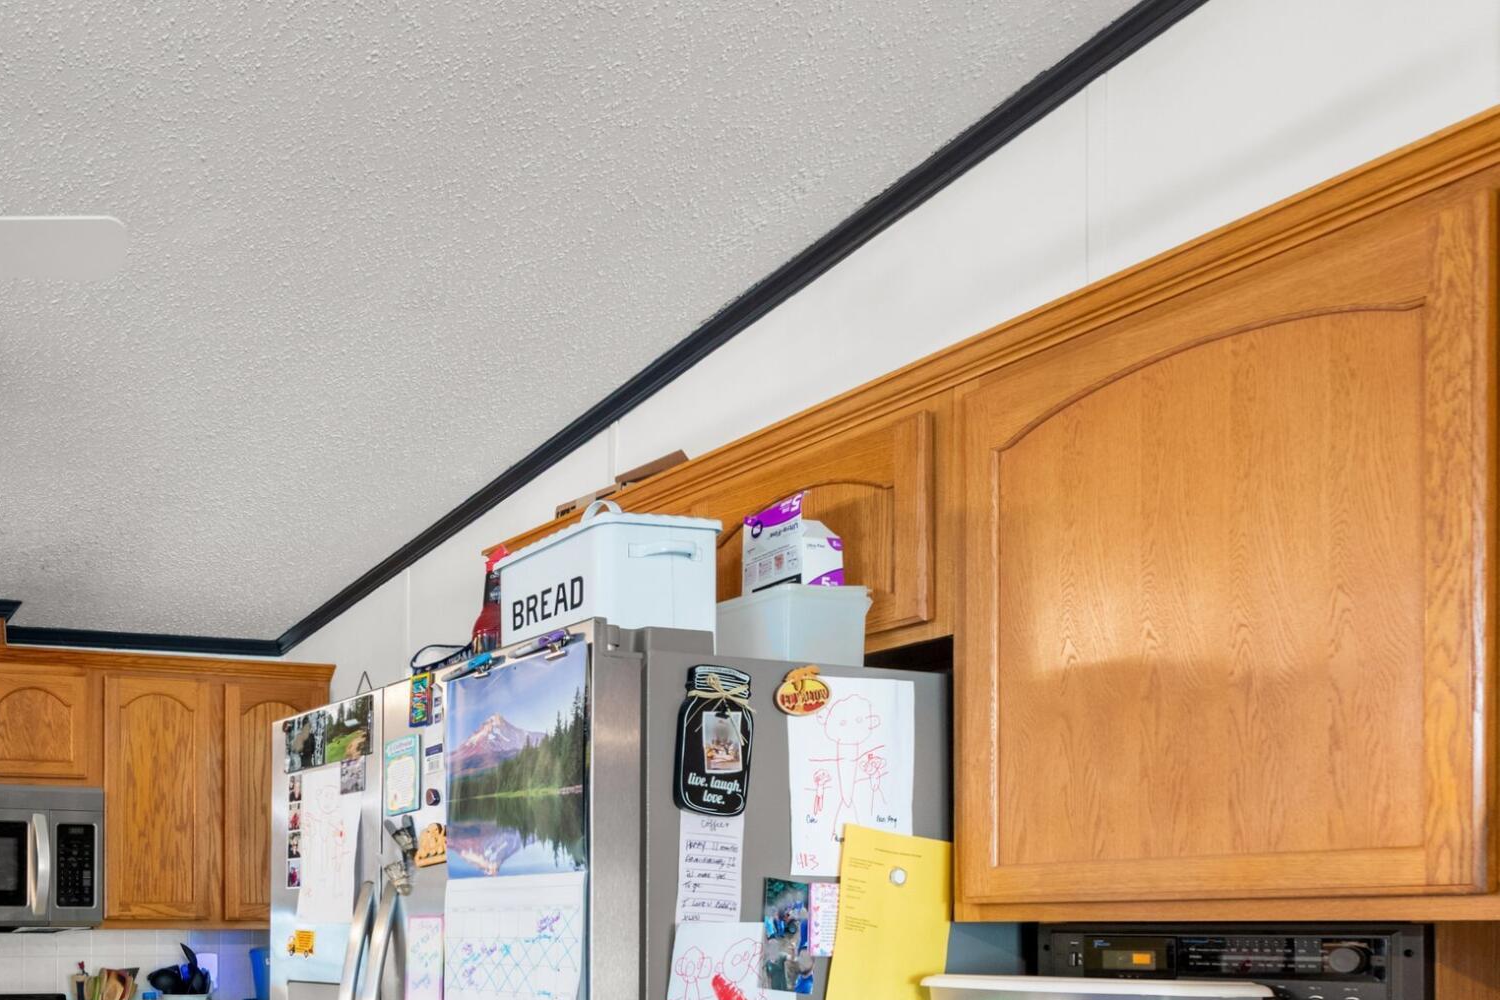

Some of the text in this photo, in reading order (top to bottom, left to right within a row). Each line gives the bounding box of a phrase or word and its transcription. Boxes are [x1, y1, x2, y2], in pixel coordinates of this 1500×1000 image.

[512, 575, 584, 632] BREAD
[687, 772, 742, 794] live. laugh.
[703, 789, 725, 805] love.
